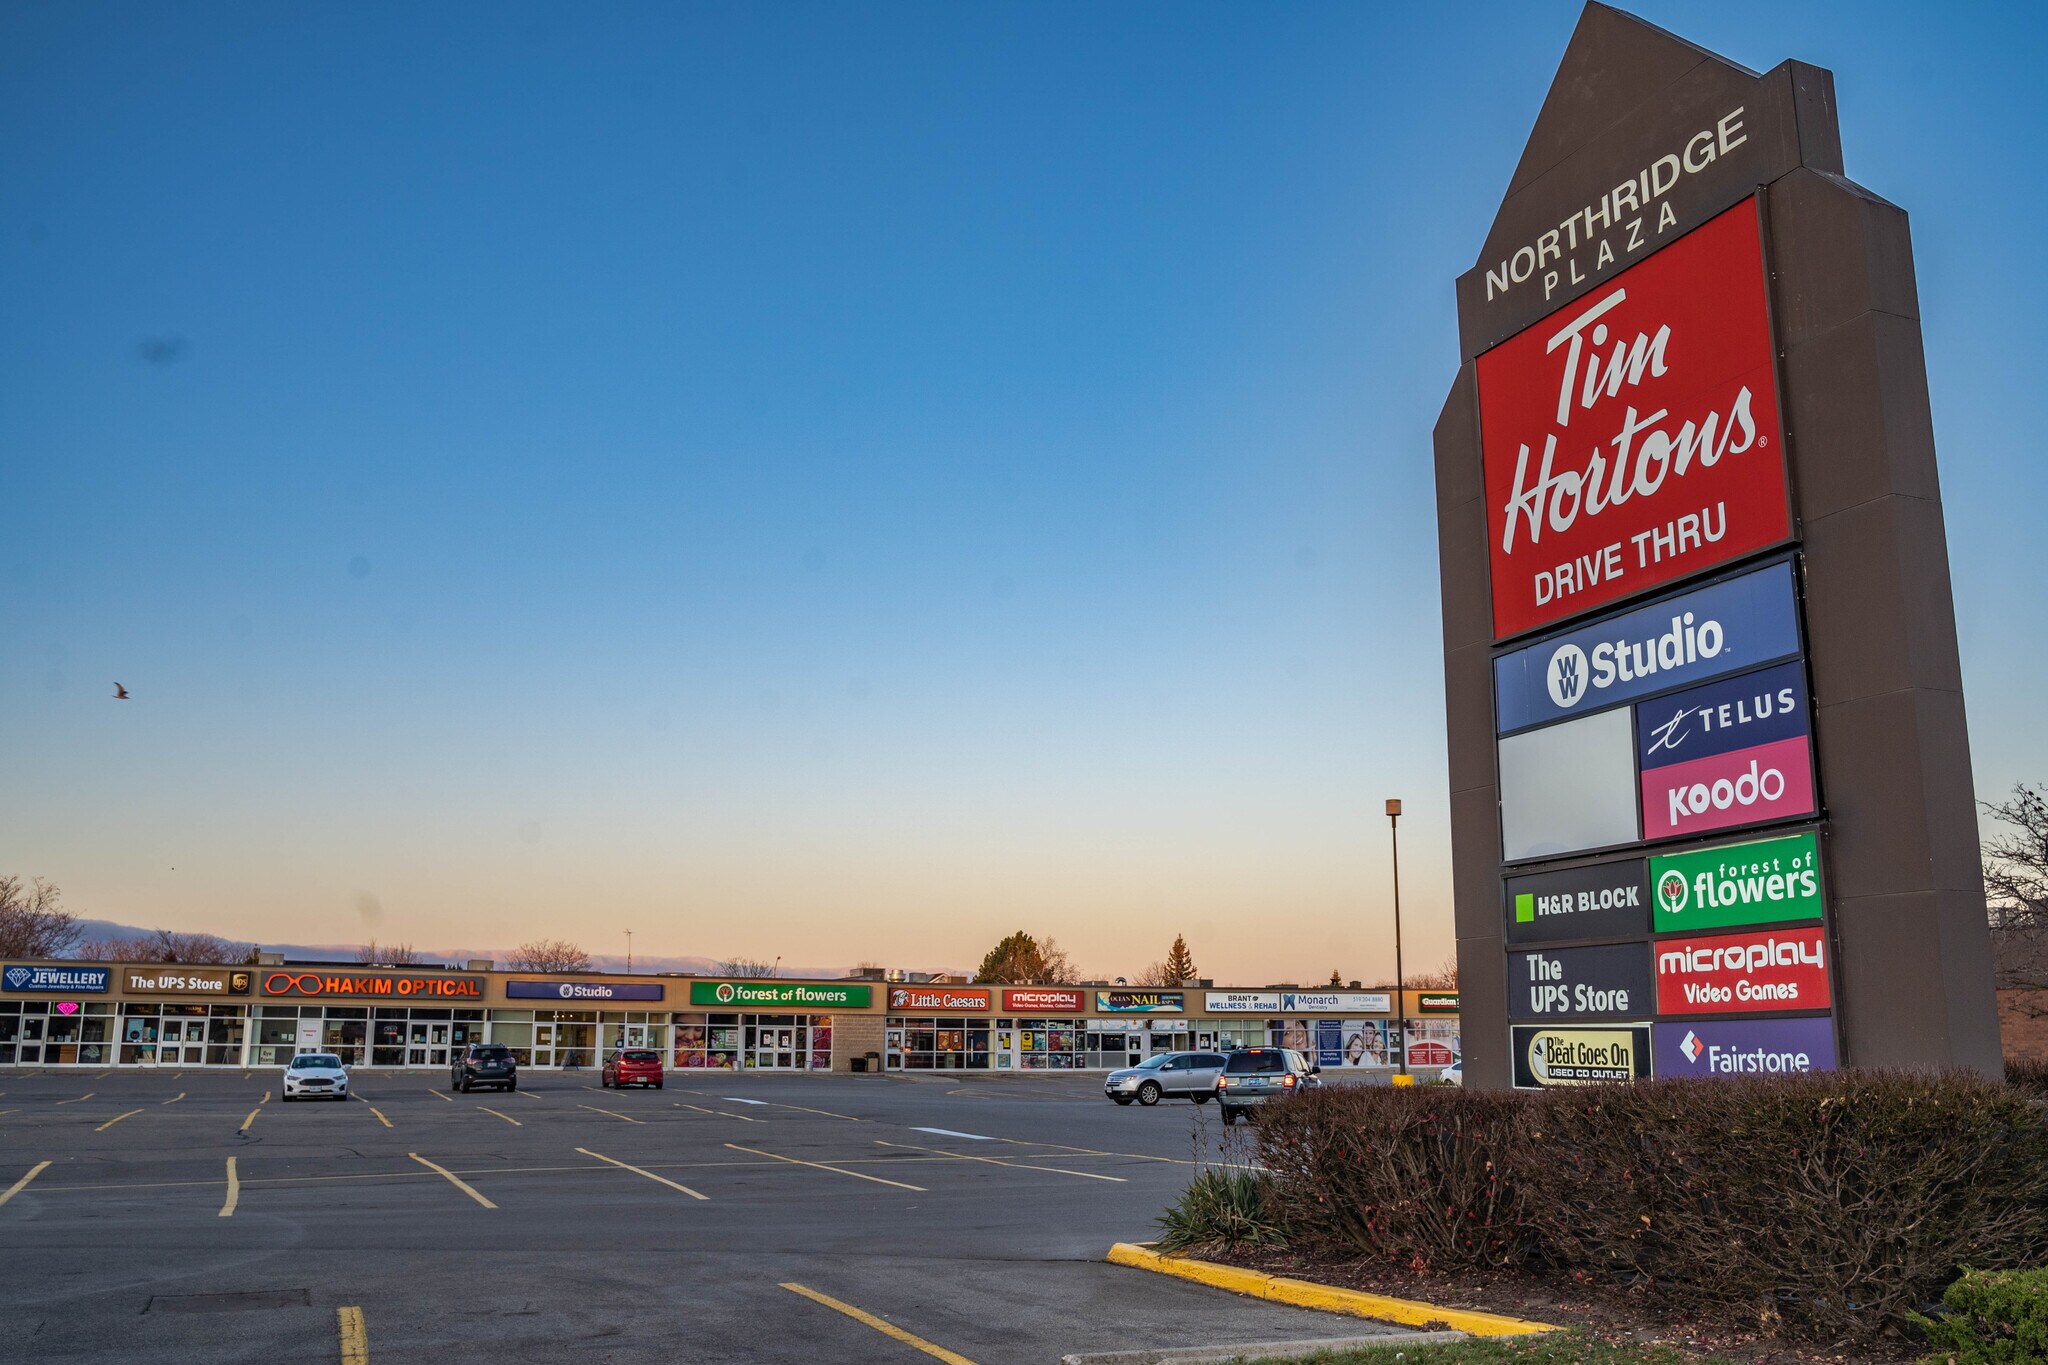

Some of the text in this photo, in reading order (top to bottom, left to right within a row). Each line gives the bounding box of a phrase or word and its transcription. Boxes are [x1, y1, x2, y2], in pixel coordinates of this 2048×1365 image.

[1486, 106, 1747, 301] NORTHRIDGE
[1545, 201, 1677, 301] PLAZA
[1547, 288, 1671, 426] Tim
[1503, 385, 1756, 554] Hortons
[1535, 502, 1726, 606] DRIVE THRU
[1592, 612, 1723, 688] Studio
[1699, 687, 1795, 732] TELUS
[1719, 851, 1812, 876] forest of
[1538, 885, 1639, 916] H&R BLOCK
[1694, 867, 1816, 908] flowers
[1526, 954, 1562, 981] The
[1659, 938, 1824, 974] microplay
[32, 972, 105, 984] JEWELLERY
[130, 976, 155, 988] The
[158, 976, 186, 989] UPS
[188, 977, 222, 990] Store
[325, 977, 480, 996] HAKIM OPTICAL
[574, 986, 613, 998] Studio
[736, 986, 847, 1002] forest of flowers
[910, 994, 986, 1008] Little Caesars
[1012, 992, 1076, 1003] microplay
[1131, 995, 1160, 1005] NAIL
[1298, 995, 1338, 1004] Monarch
[1422, 997, 1456, 1005] Guardian
[1530, 983, 1628, 1013] UPS Store
[1683, 979, 1798, 1004] Video Games
[1546, 1037, 1629, 1066] Beat Goes On
[1554, 1037, 1564, 1046] The
[1708, 1045, 1809, 1073] Fairstone
[1549, 1068, 1628, 1079] USED CD OUTLET
